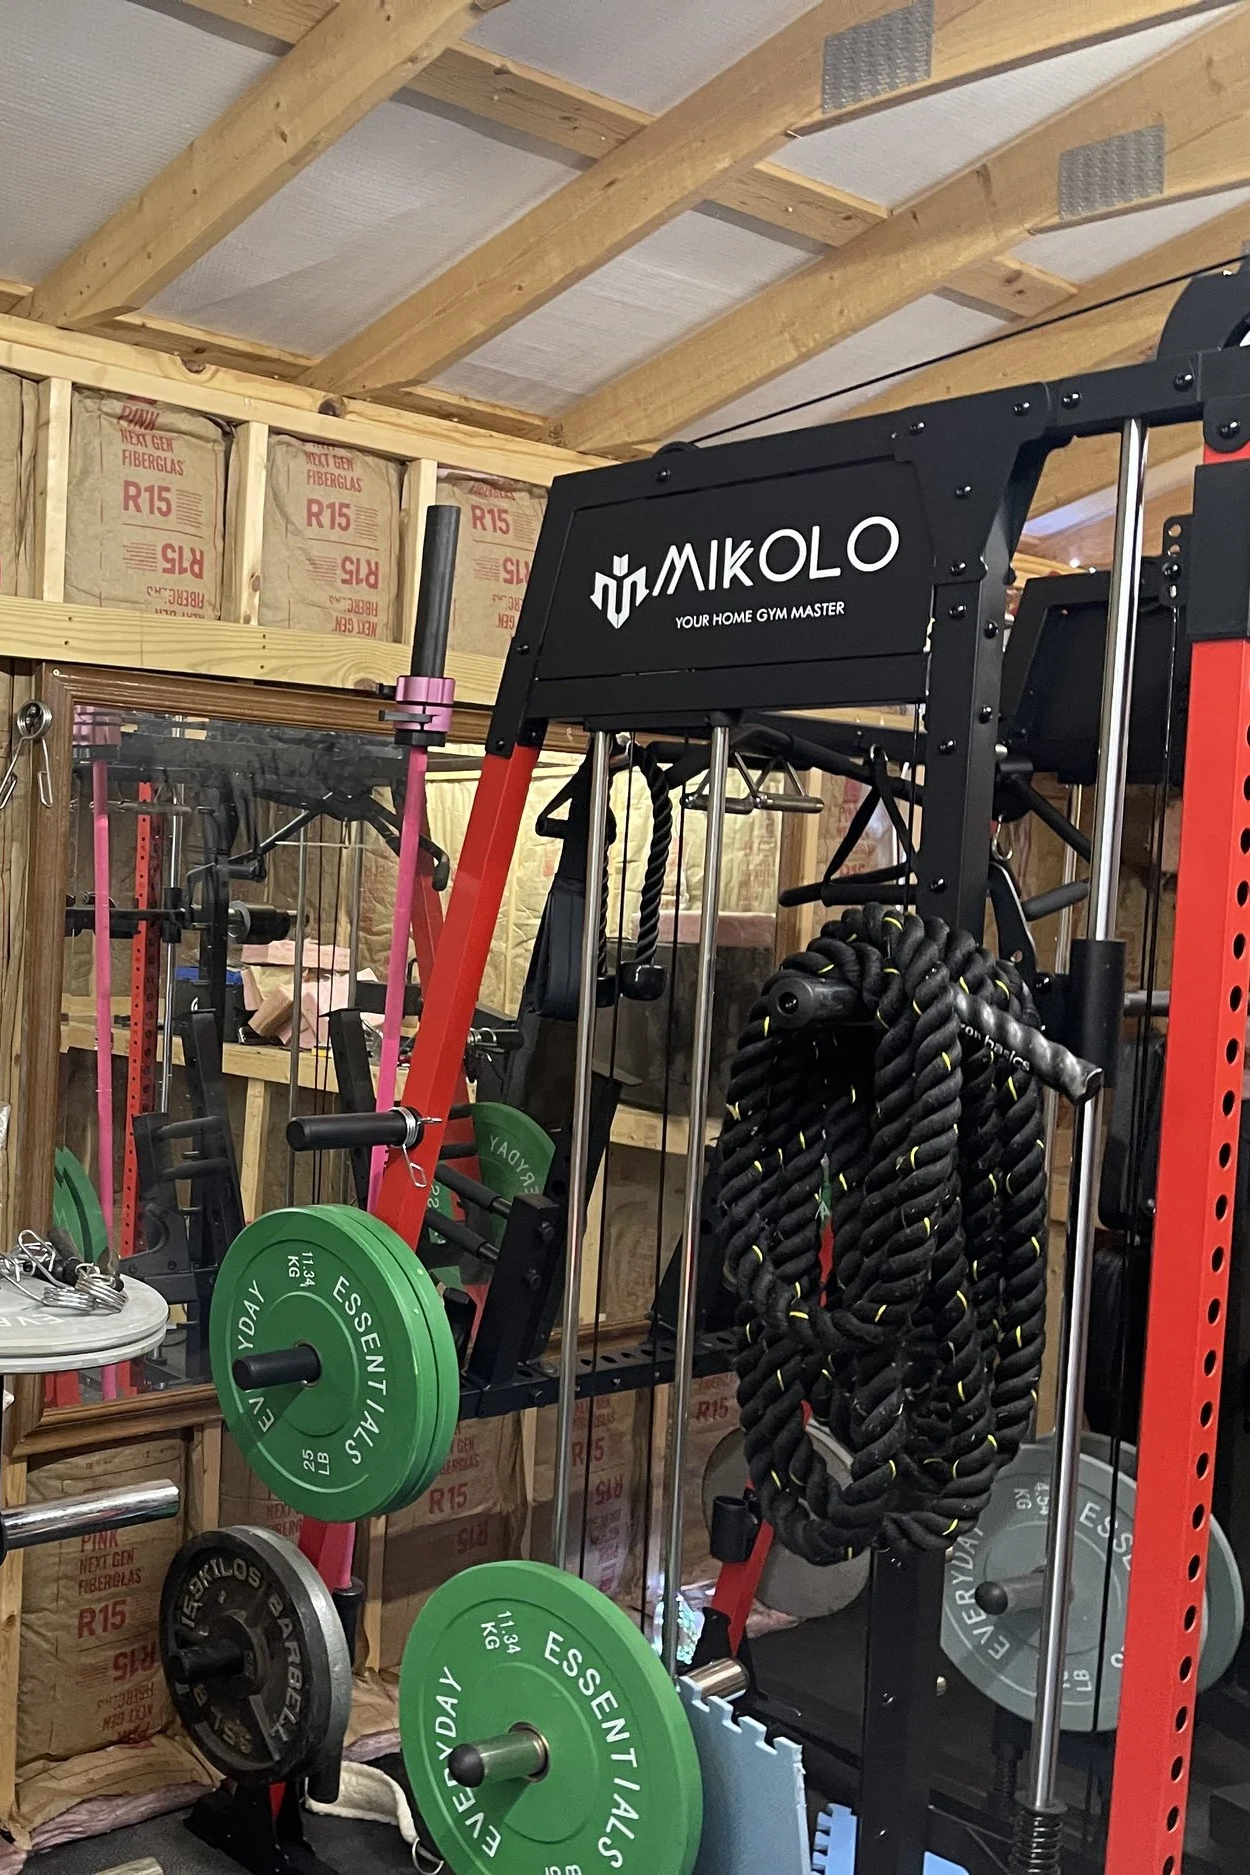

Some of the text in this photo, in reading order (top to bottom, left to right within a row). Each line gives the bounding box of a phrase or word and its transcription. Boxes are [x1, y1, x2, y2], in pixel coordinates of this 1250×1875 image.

[119, 429, 174, 453] NEXT GEN
[122, 449, 184, 476] FIBERGLAS
[306, 453, 353, 472] NEXT GEN
[307, 469, 362, 493] FIBERGLAS
[123, 480, 172, 517] R15
[306, 498, 351, 532] R15
[471, 505, 511, 535] R15
[161, 543, 204, 579] R15
[652, 516, 899, 597] MIKOLO
[341, 556, 379, 589] R15
[335, 616, 377, 637] NEXT GEN
[676, 602, 845, 629] YOUR HOME GYM MASTER
[288, 1256, 300, 1278] KG
[299, 1251, 315, 1288] 11.34
[237, 1280, 275, 1433] EVYDAY
[333, 1275, 387, 1465] ESSENTIALS
[302, 1449, 315, 1472] 25
[317, 1452, 330, 1475] LB
[429, 1483, 468, 1514] R15
[1014, 1488, 1032, 1509] KG
[80, 1549, 134, 1575] NEXT GEN
[78, 1568, 141, 1596] FIBERGLAS
[77, 1600, 126, 1639] R15
[498, 1610, 521, 1654] 11.34
[481, 1622, 500, 1650] KG
[268, 1594, 302, 1742] BARBELL
[1074, 1669, 1092, 1692] LB
[544, 1631, 641, 1868] ESSENTIALS
